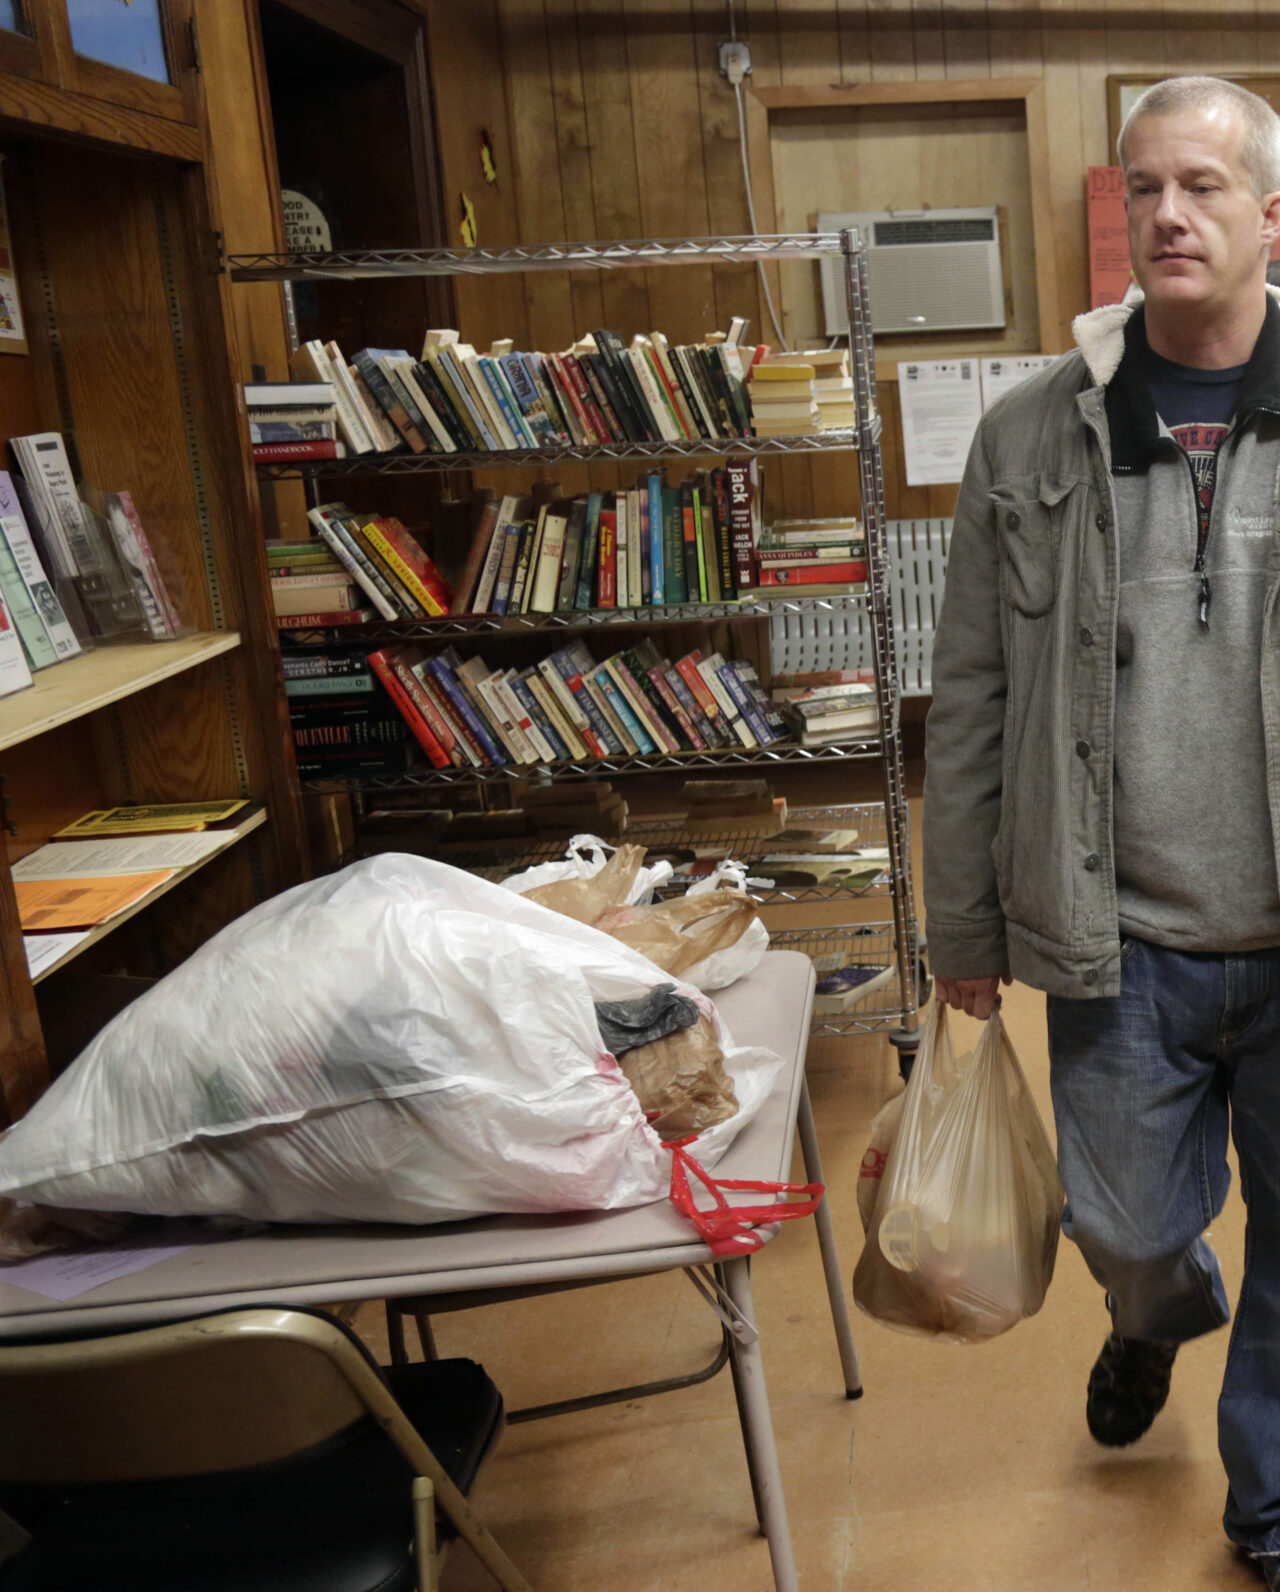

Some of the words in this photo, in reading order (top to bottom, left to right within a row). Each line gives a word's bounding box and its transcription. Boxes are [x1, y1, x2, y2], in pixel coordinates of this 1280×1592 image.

[282, 201, 303, 210] OOD
[285, 212, 310, 221] NTRY
[286, 226, 313, 236] EASE
[287, 236, 299, 246] KE
[727, 467, 749, 503] jack
[278, 614, 322, 627] ULGHUM
